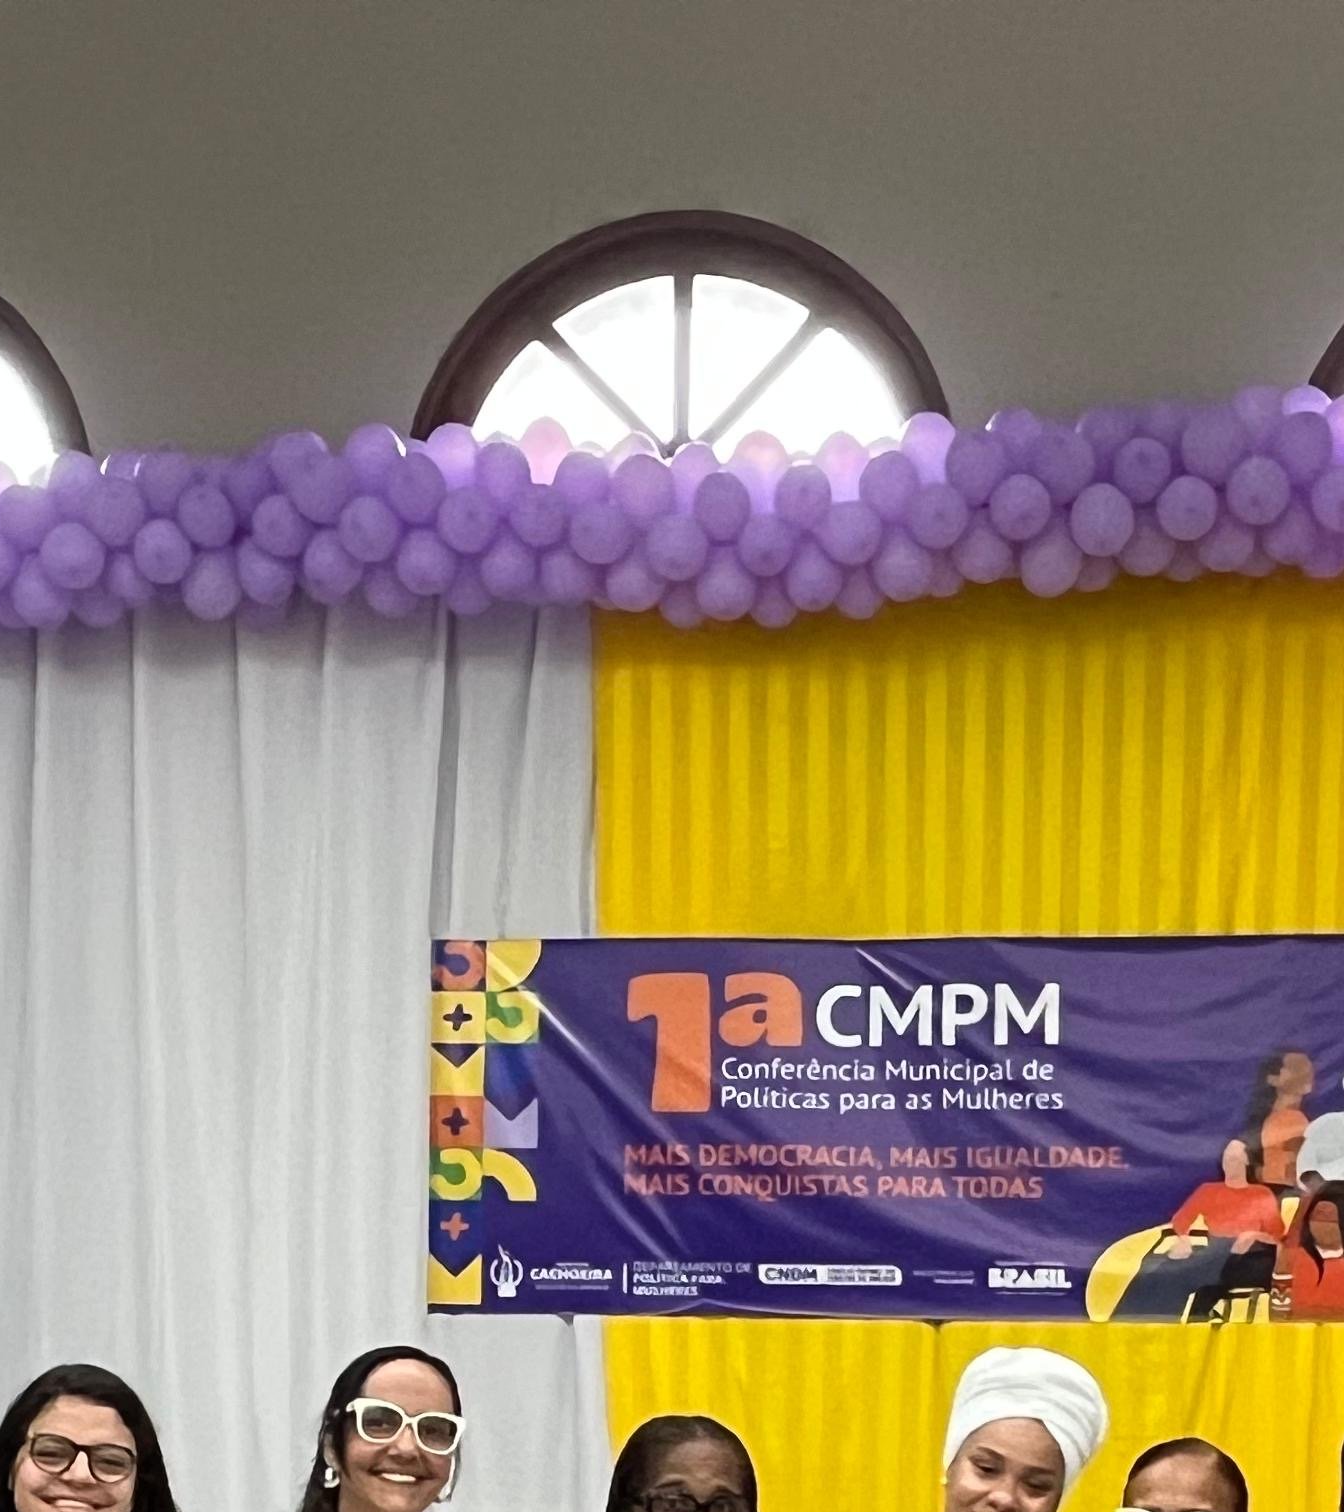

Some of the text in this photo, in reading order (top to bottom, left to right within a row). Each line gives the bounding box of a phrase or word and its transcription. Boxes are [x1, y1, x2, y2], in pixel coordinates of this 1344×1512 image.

[815, 982, 1060, 1047] CMPM
[721, 1057, 1054, 1085] Conferência Municipal de
[721, 1085, 1064, 1114] Políticas para as Mulheres
[624, 1144, 691, 1167] MAIS
[699, 1144, 884, 1171] DEMOCRACIA,
[889, 1146, 958, 1168] MAIS
[624, 1173, 1044, 1202] MAIS CONQUISTAS PARA TODAS
[988, 1268, 1072, 1288] BRASIL
